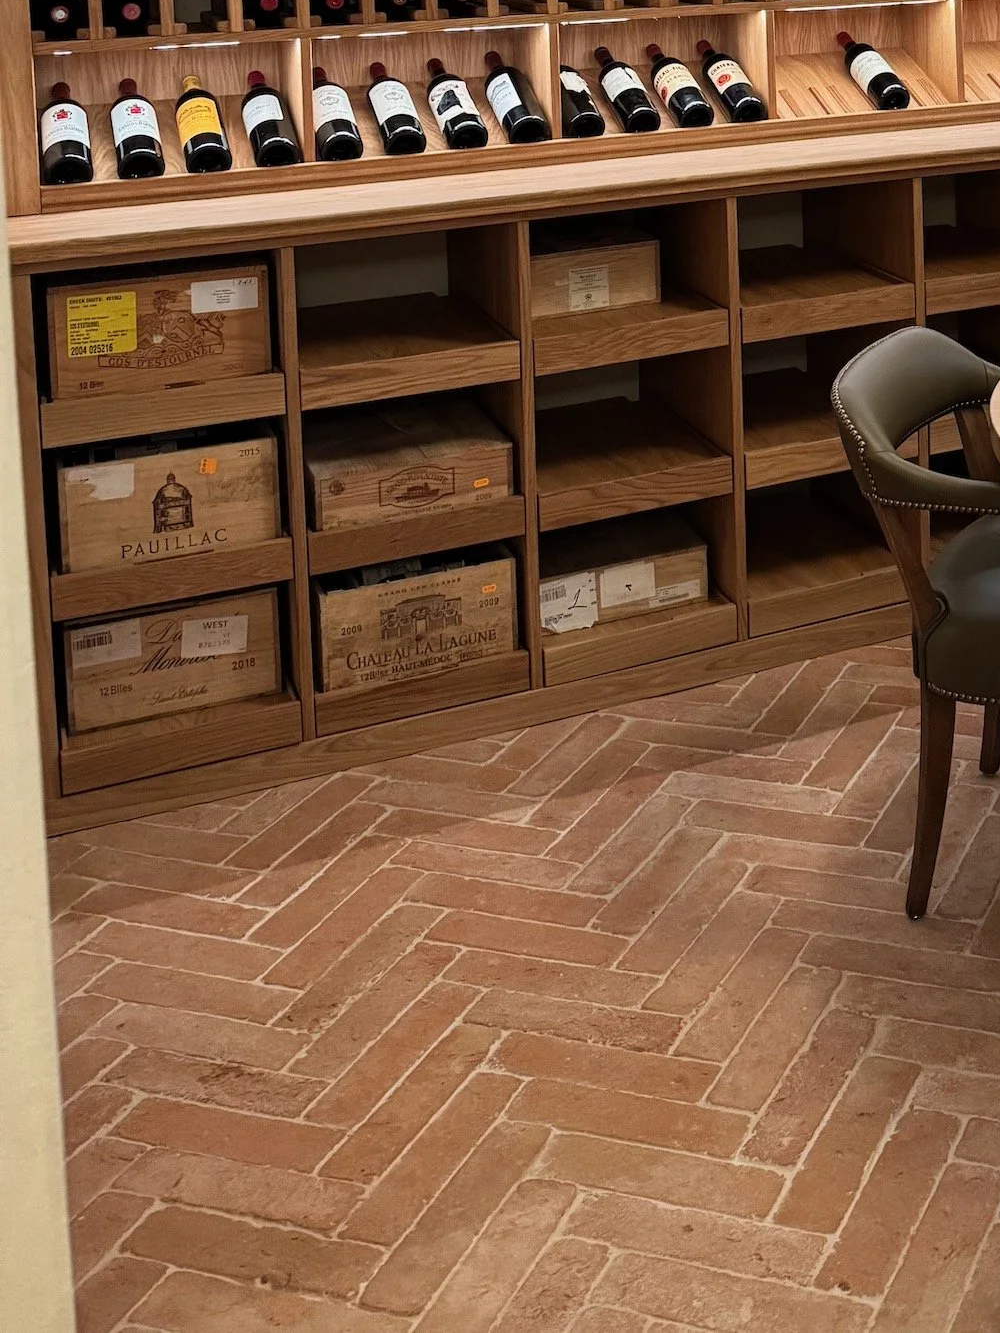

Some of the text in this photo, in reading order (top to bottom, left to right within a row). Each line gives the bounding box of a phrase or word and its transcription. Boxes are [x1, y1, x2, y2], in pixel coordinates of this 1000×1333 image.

[70, 343, 113, 356] 2004 025216
[108, 345, 215, 368] COS D'ESTOURNEL
[79, 381, 88, 390] 12
[239, 446, 260, 458] 2015
[120, 528, 228, 559] PAUILLAC
[479, 596, 499, 608] 2009
[202, 619, 229, 630] WEST
[340, 624, 363, 637] 2009
[439, 628, 497, 653] LAGUNE
[231, 657, 256, 671] 2018
[100, 687, 109, 697] 12
